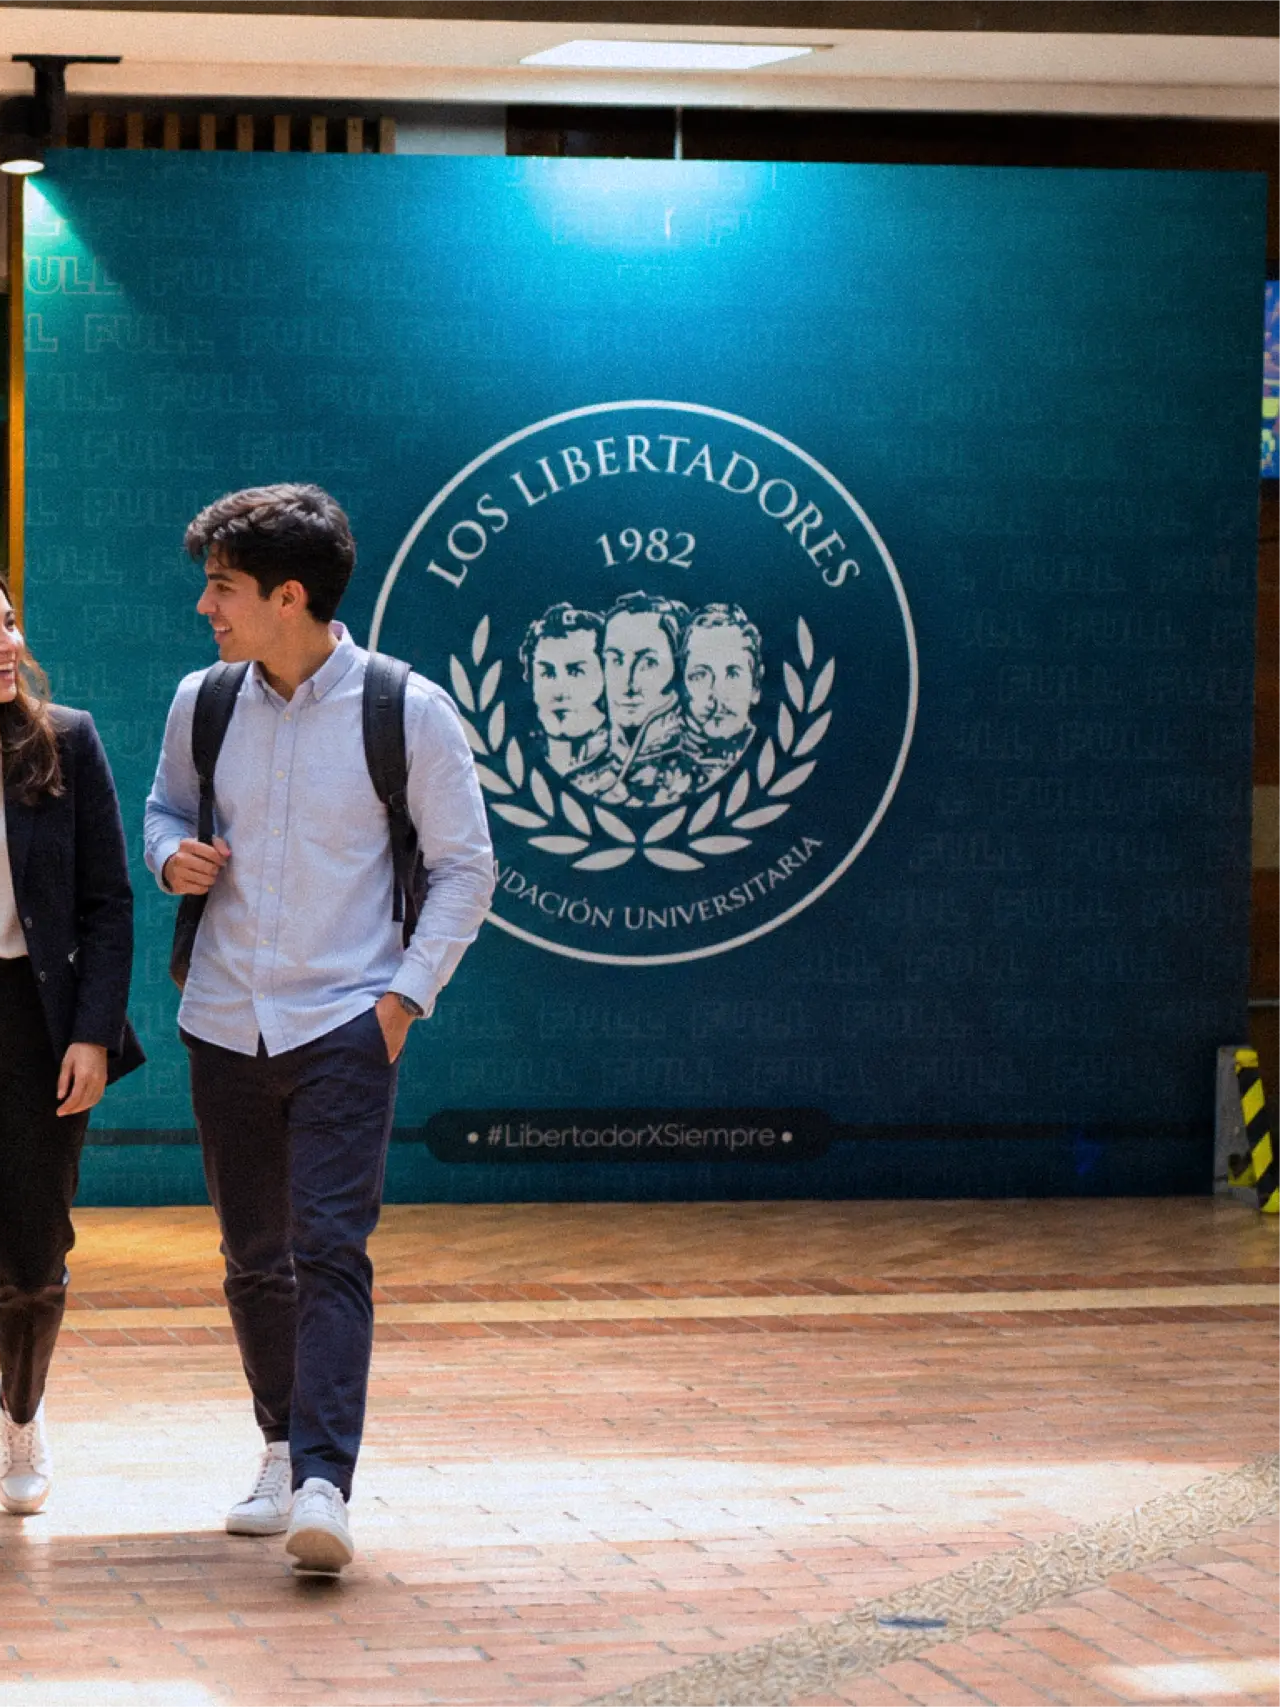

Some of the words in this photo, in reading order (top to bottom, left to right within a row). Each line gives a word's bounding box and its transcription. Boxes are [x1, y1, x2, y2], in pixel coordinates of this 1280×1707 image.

[24, 255, 123, 295] ULL
[426, 494, 508, 588] LOS
[510, 434, 861, 588] LIBERTADORES
[595, 527, 697, 568] 1982
[493, 859, 614, 928] NDACIÓN
[624, 835, 822, 930] UNIVERSITARIA
[487, 1123, 776, 1151] #LibertadorXSiempre
